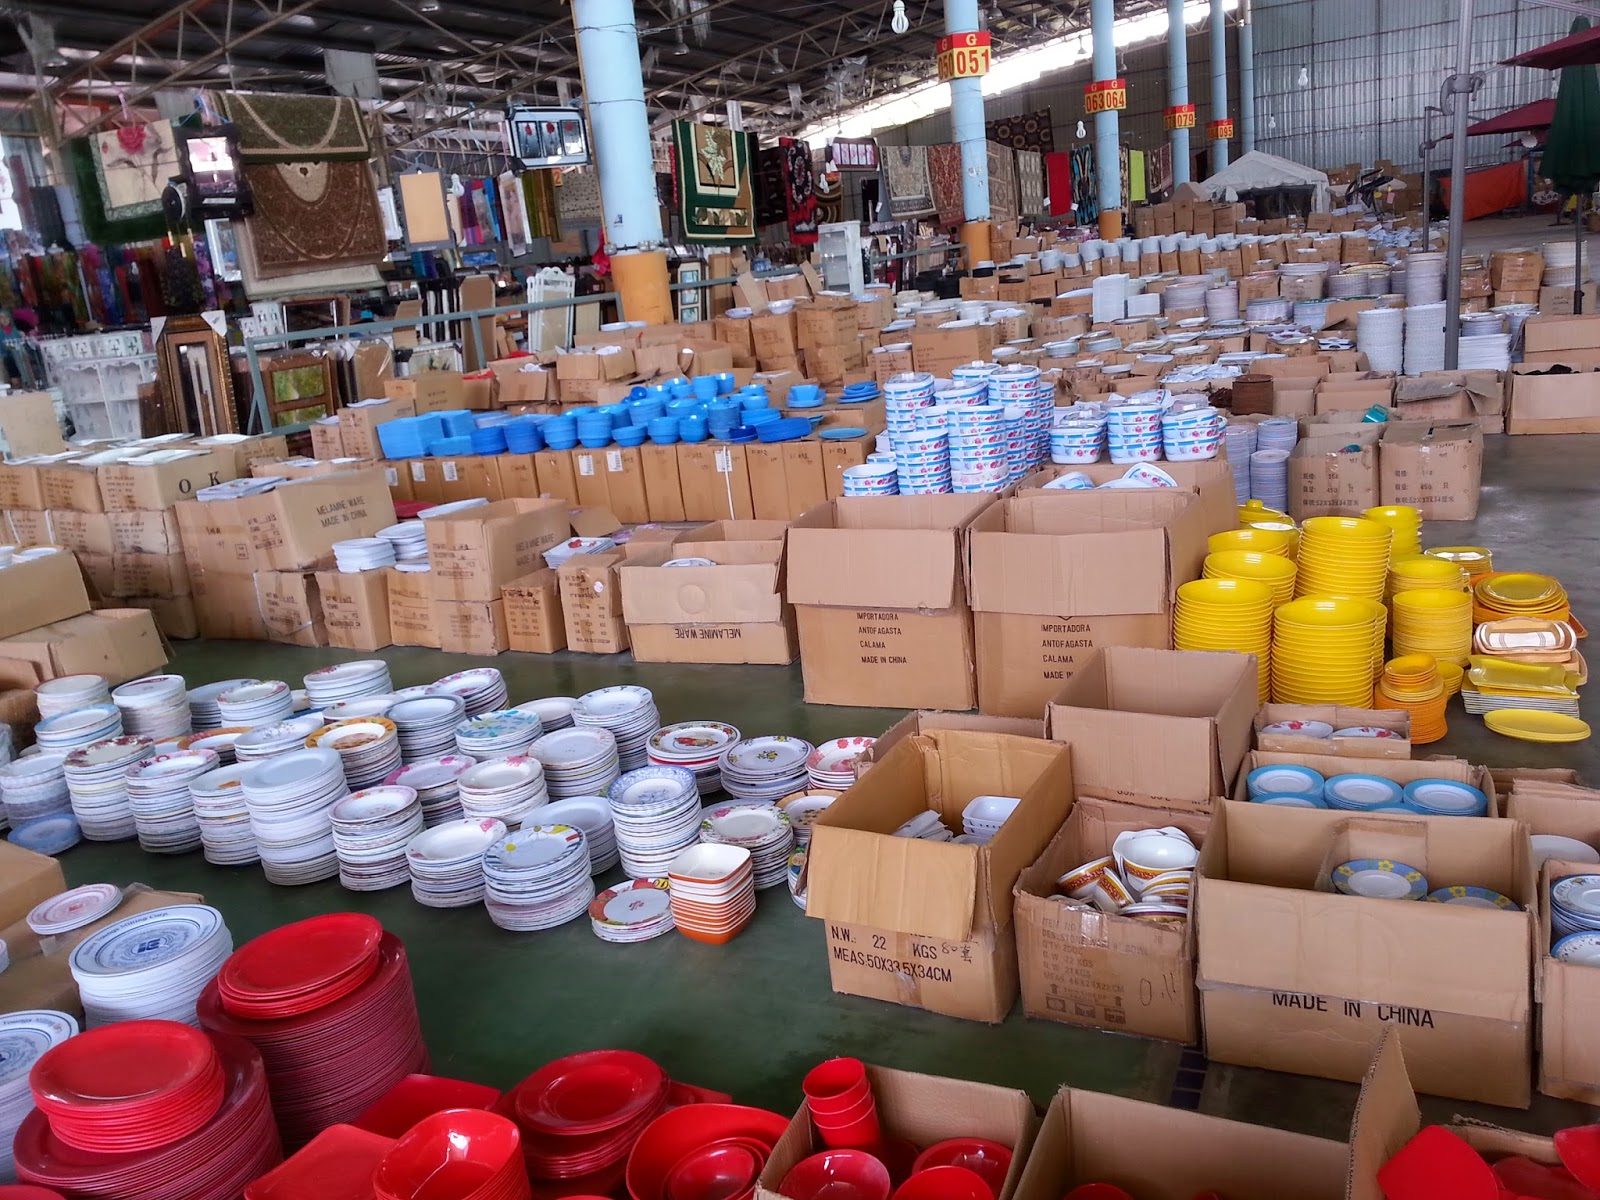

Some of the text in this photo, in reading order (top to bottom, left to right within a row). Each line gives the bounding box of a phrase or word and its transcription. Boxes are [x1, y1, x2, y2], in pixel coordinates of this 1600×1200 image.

[942, 39, 947, 50] G
[966, 34, 977, 46] G
[938, 53, 954, 80] 050
[957, 49, 989, 75] 051
[1086, 93, 1104, 112] 063
[1106, 91, 1124, 108] 064
[1177, 114, 1194, 126] 079
[1220, 127, 1232, 138] 095
[179, 471, 220, 494] O K
[856, 612, 899, 621] IMPORTADORA
[674, 628, 742, 639] MELAMINE WARE
[859, 626, 902, 635] ANTOFAGASTA
[1041, 624, 1091, 633] IMPORTADORA
[860, 640, 886, 649] CALAMA
[1042, 639, 1093, 648] ANTOFAGASTA
[861, 656, 907, 664] MADE IN CHINA
[1042, 654, 1074, 663] CALAMA
[1043, 671, 1064, 679] MADE
[831, 925, 857, 943] N.W.:
[872, 935, 887, 950] 22
[912, 943, 937, 960] KGS
[833, 946, 952, 982] MEAS:50X335X34CM
[1273, 993, 1435, 1029] MADE IN CHINA
